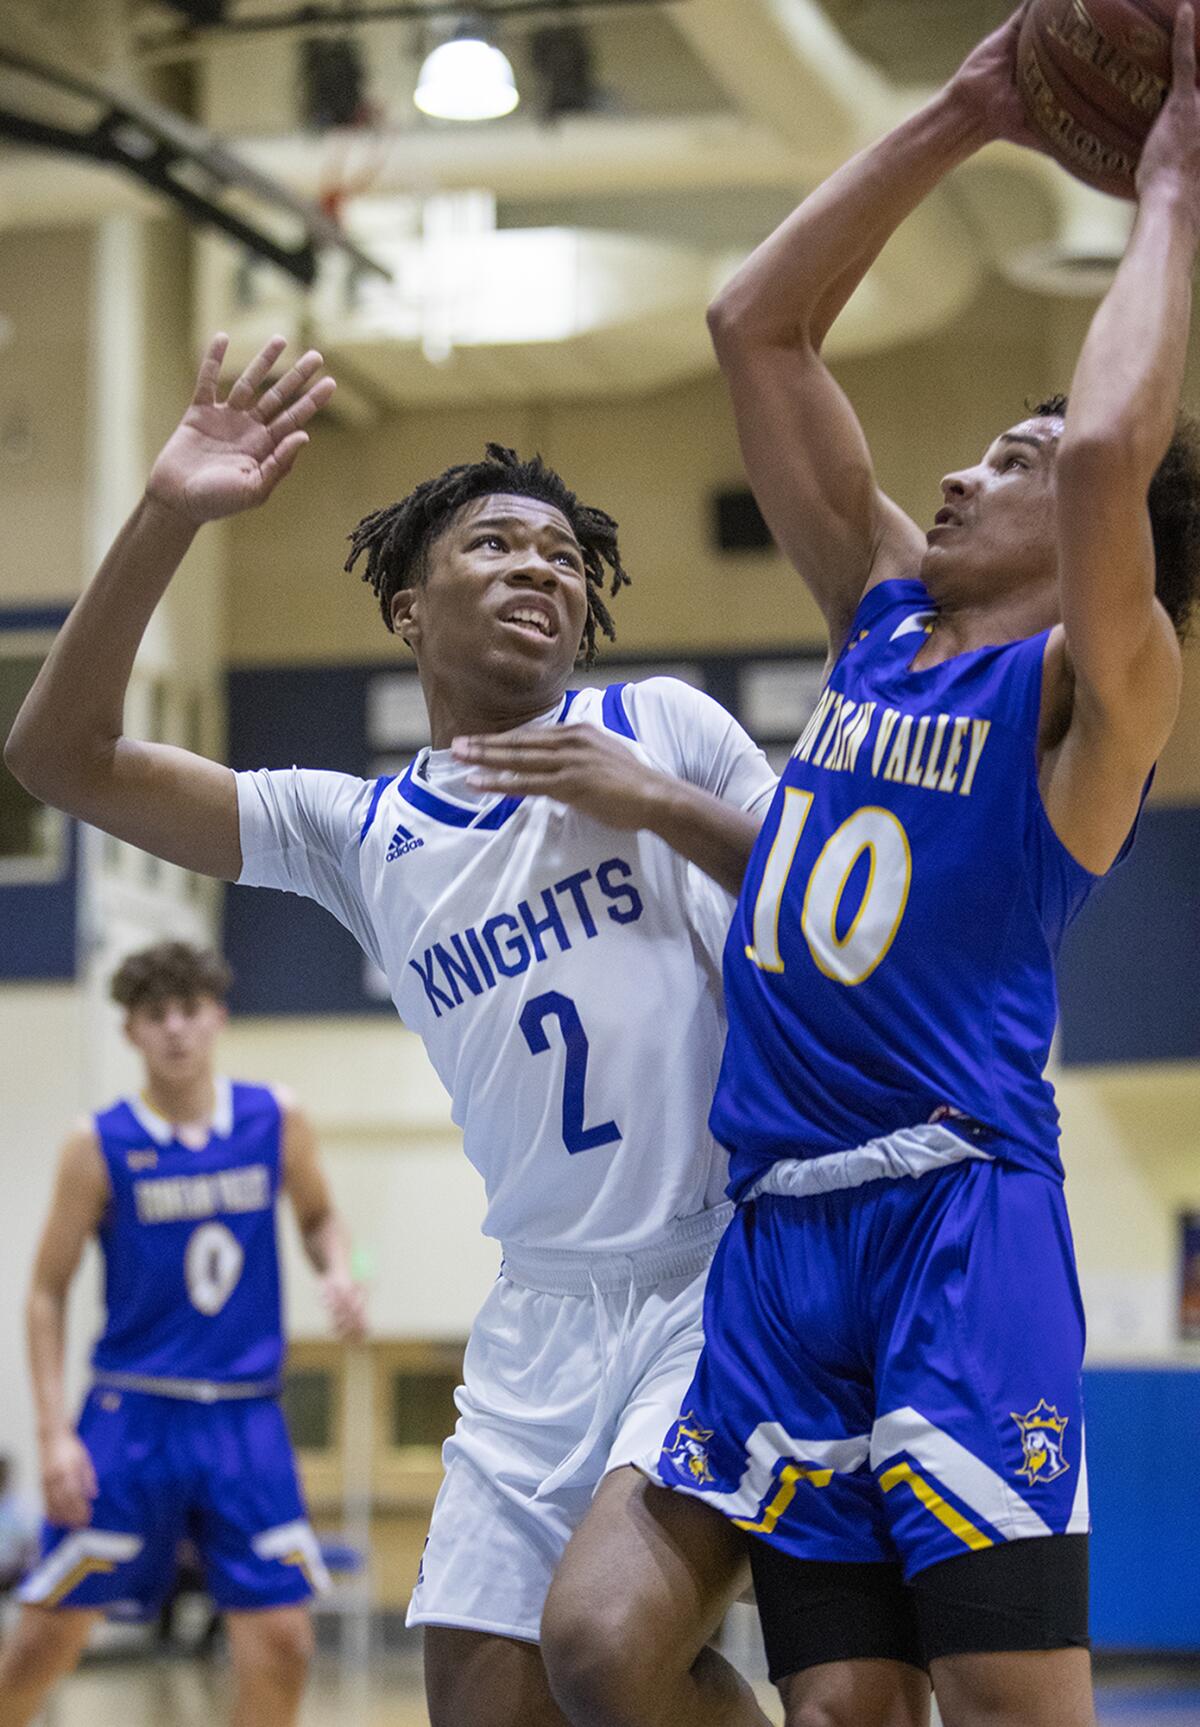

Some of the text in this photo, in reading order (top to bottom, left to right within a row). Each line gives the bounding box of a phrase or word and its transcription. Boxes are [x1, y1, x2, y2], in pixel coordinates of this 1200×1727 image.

[871, 708, 992, 796] VALLEY
[386, 838, 425, 863] adidas
[745, 786, 912, 986] 10
[409, 858, 644, 1018] KNIGHTS
[518, 990, 623, 1155] 2
[183, 1220, 245, 1317] 0
